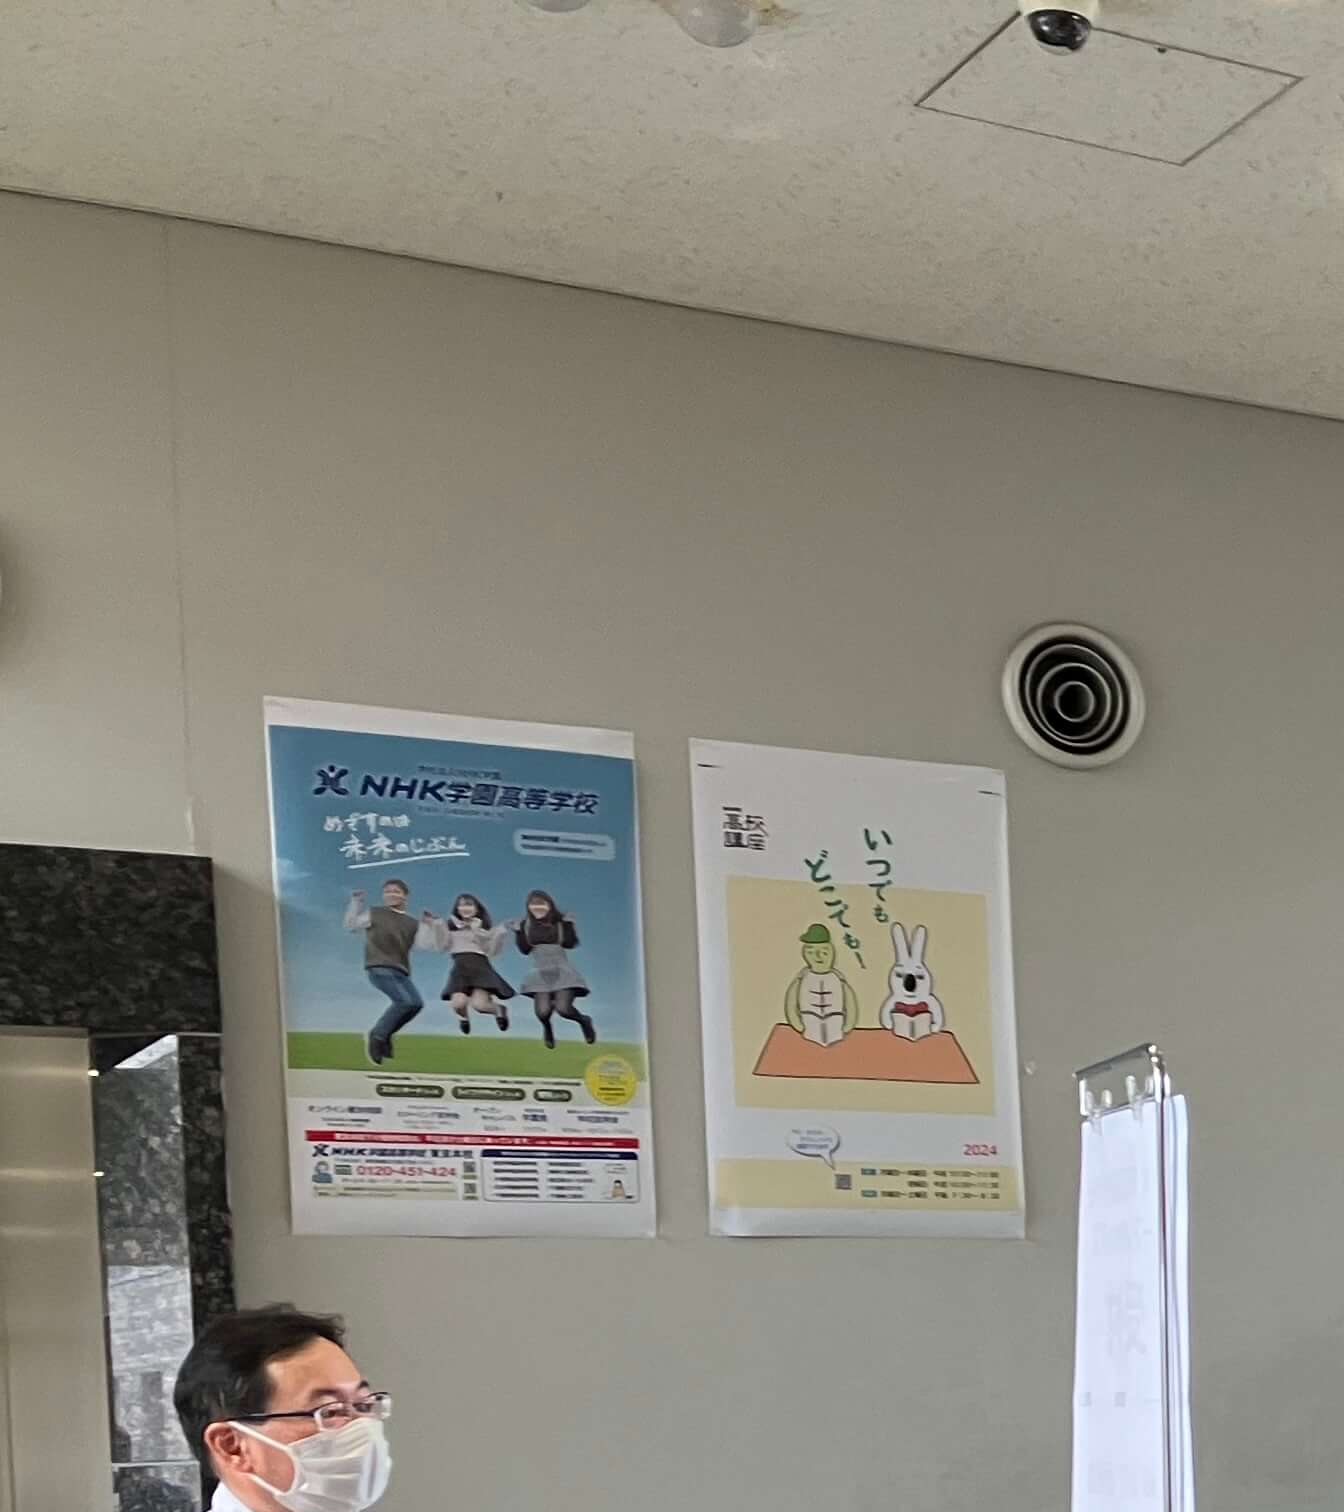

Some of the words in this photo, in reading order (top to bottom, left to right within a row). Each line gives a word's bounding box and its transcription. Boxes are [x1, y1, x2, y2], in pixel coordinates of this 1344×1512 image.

[360, 774, 599, 815] NHK学園高等学校
[864, 828, 893, 923] いつでも
[963, 1143, 998, 1156] 2024
